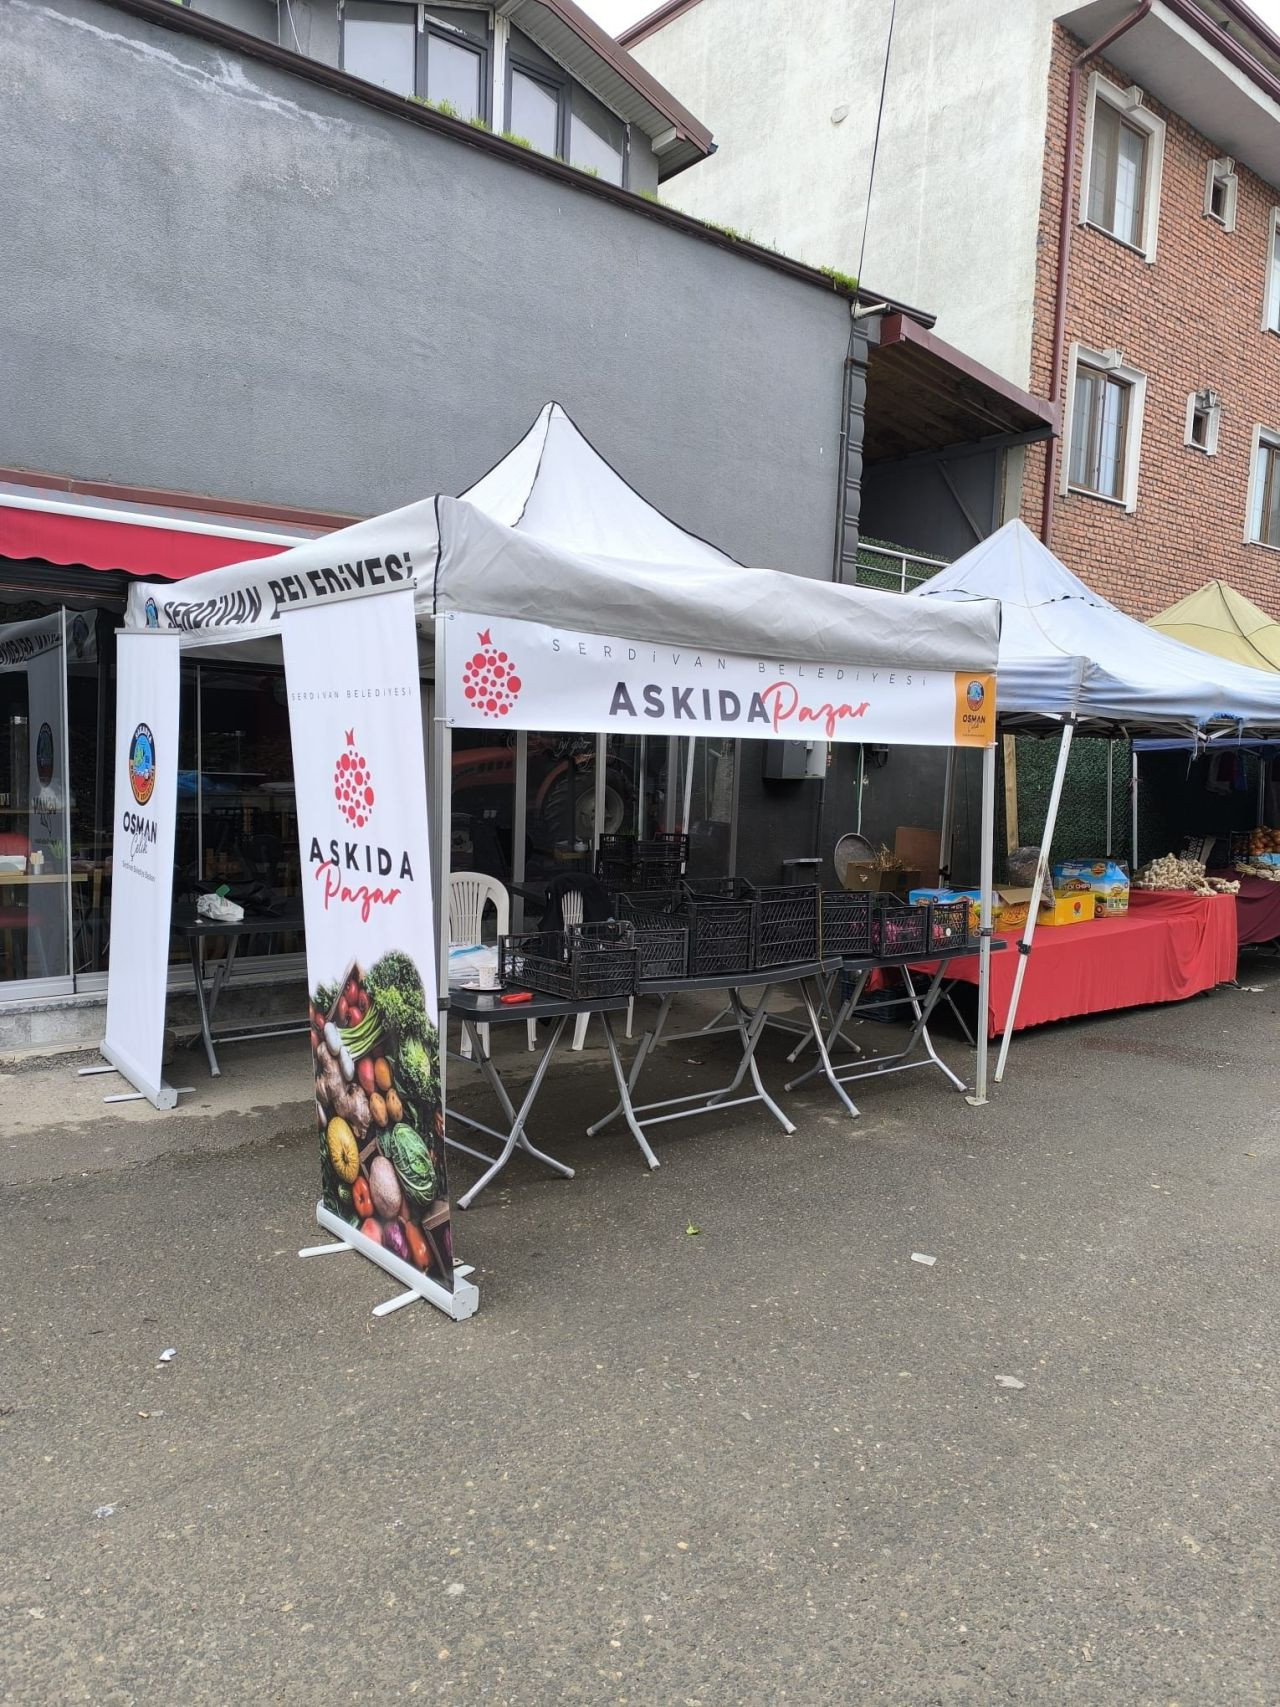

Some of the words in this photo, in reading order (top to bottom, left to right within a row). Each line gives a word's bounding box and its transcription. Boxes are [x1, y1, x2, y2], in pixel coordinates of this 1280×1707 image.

[608, 681, 771, 724] ASKIDA
[760, 680, 871, 739] Pazar
[962, 714, 986, 724] OSMAN
[123, 811, 158, 845] OSMAN
[309, 836, 414, 882] ASKIDA
[315, 859, 402, 923] Pazar
